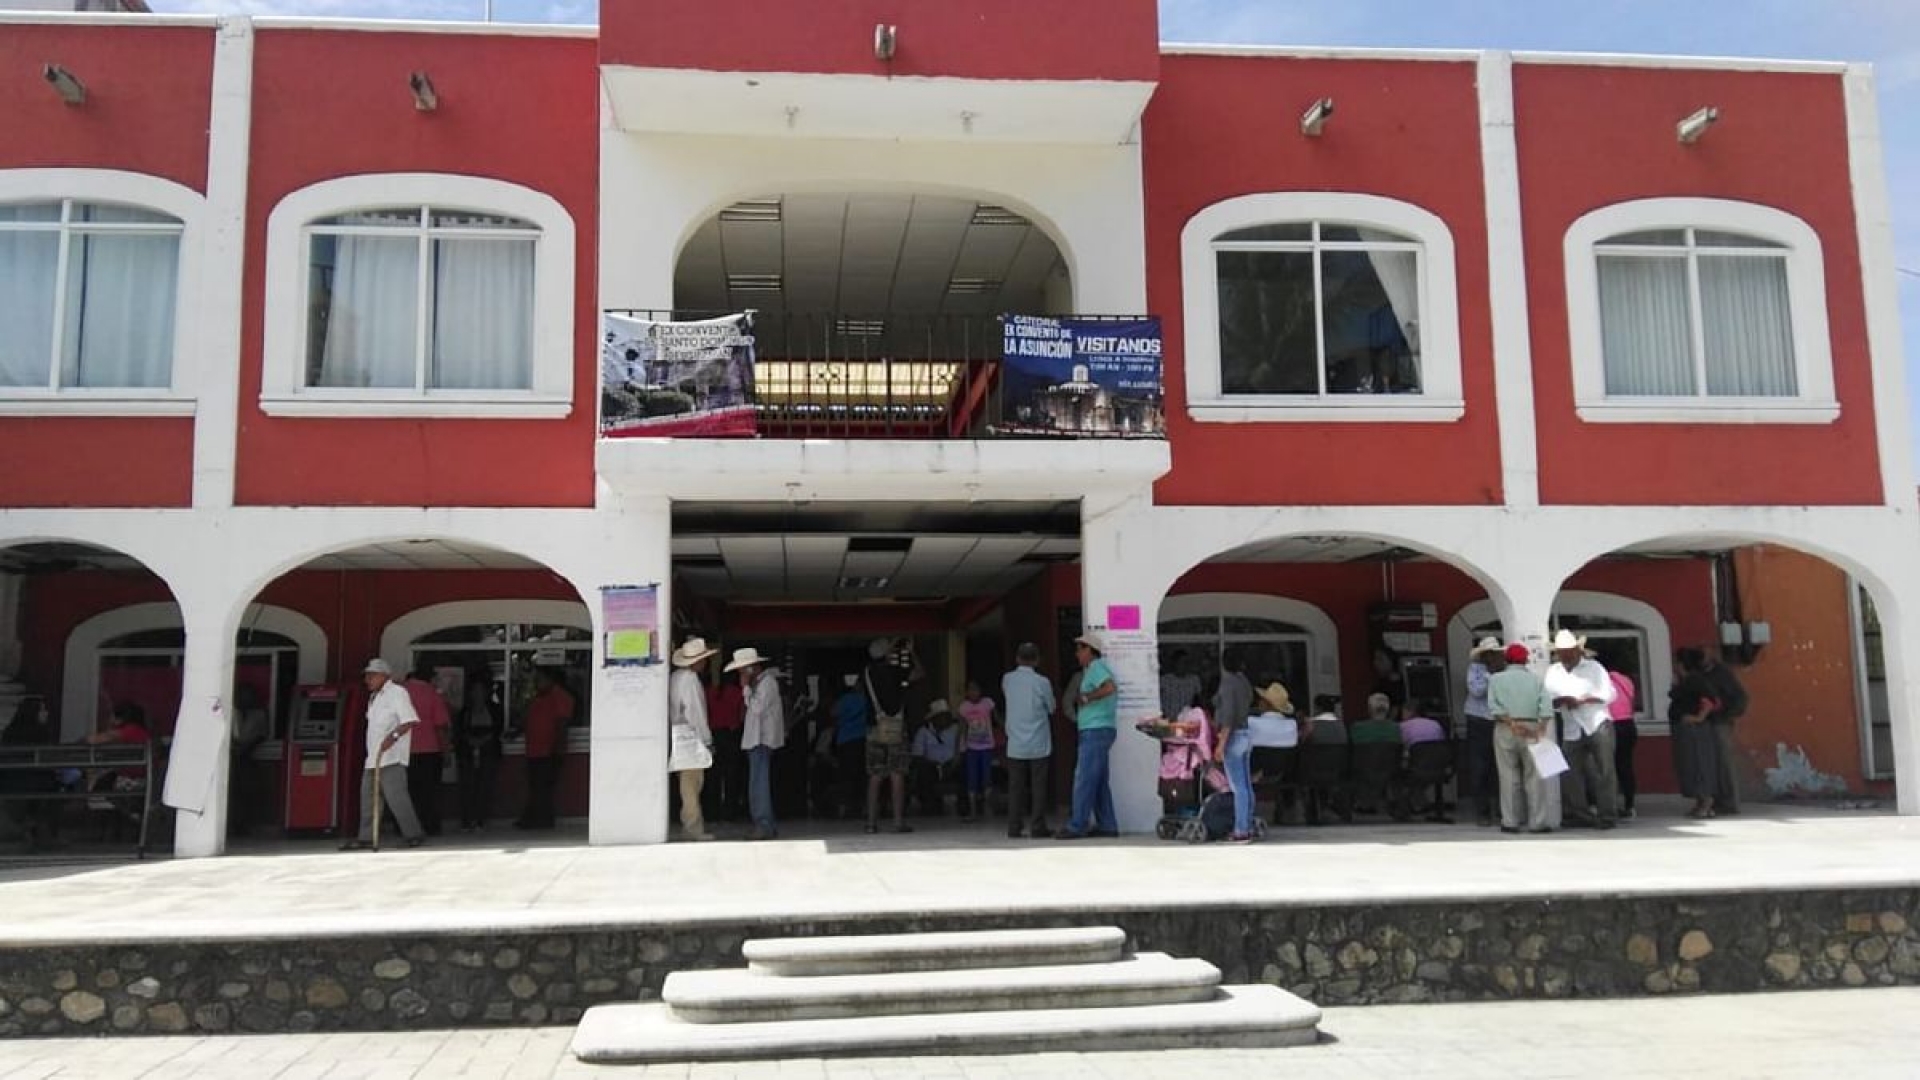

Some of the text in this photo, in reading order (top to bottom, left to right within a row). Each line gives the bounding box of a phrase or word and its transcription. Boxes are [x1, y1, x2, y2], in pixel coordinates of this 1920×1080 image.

[1005, 324, 1015, 336] EX
[1004, 338, 1017, 354] LA
[1077, 336, 1161, 353] VISITANOS
